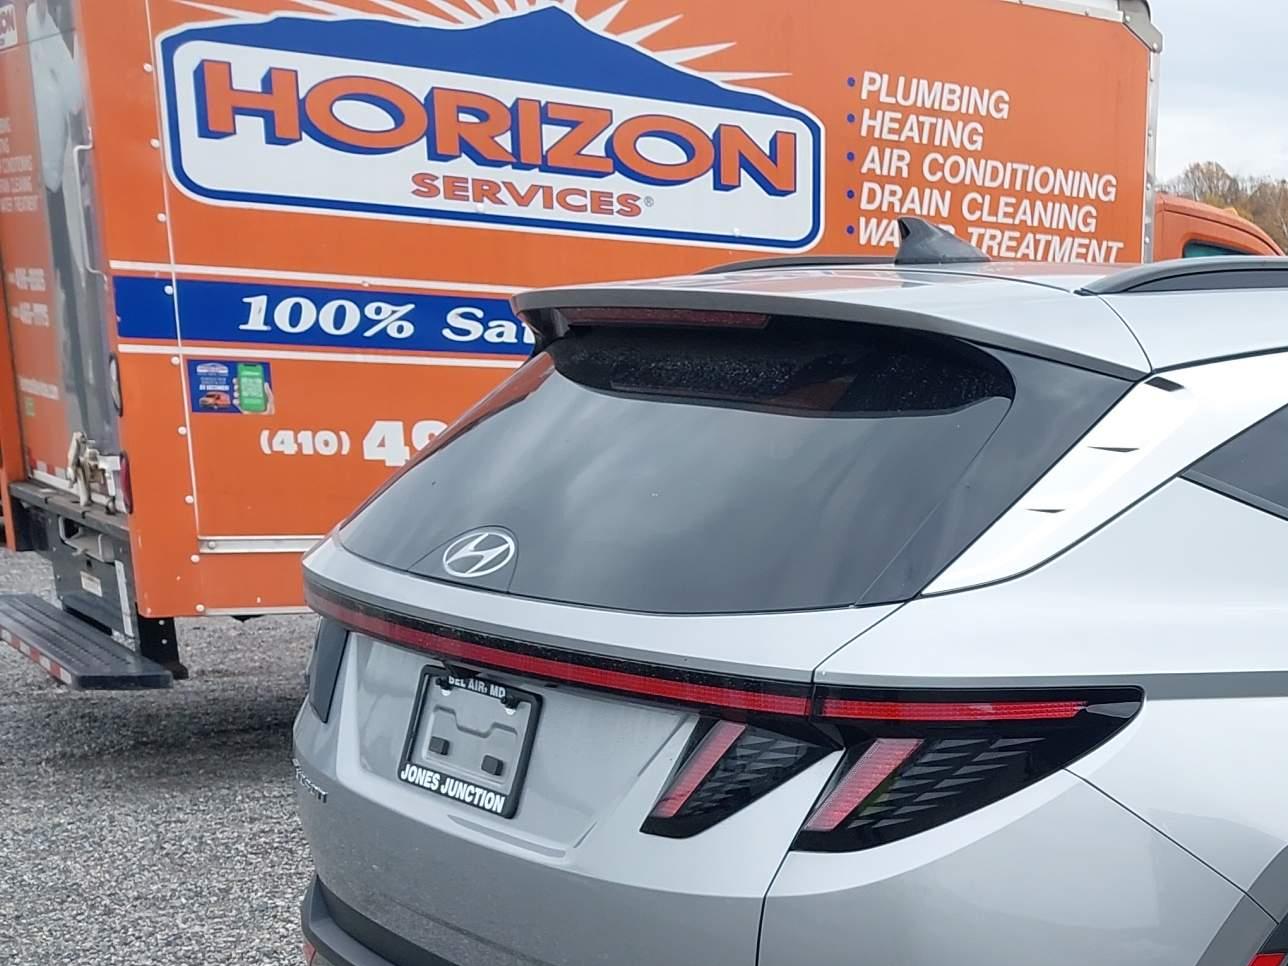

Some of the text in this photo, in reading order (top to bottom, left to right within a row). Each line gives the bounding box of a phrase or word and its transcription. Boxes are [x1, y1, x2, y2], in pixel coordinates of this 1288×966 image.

[861, 71, 1010, 119] PLUMBING
[194, 58, 796, 195] HORIZON
[861, 108, 983, 150] HEATING
[861, 146, 1118, 202] AIR CONDITIONING
[860, 181, 952, 217] DRAIN
[962, 192, 1098, 232] CLEANING
[968, 226, 1124, 263] TREATMENT
[238, 295, 416, 339] 100%
[260, 429, 350, 455] (410)
[489, 684, 506, 698] MD
[401, 763, 506, 813] JONES JUNCTION
